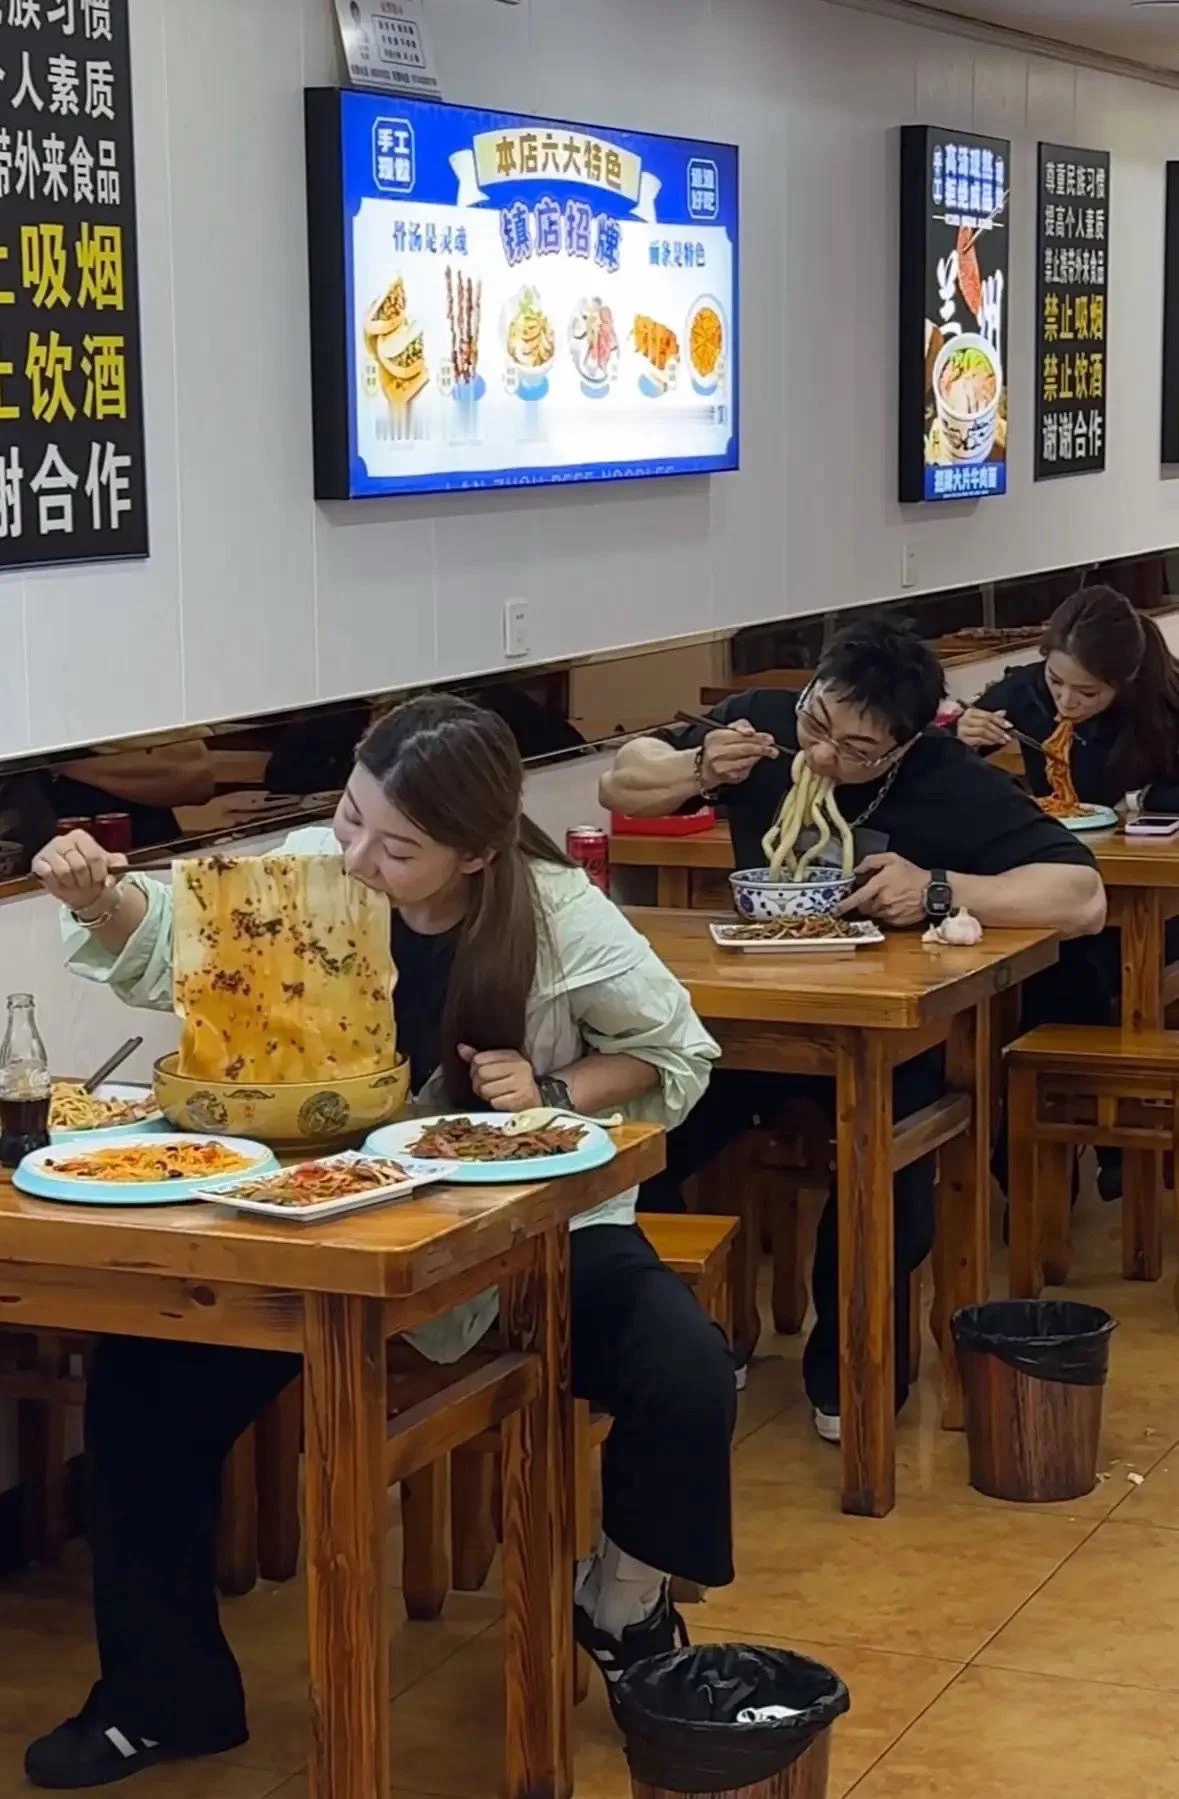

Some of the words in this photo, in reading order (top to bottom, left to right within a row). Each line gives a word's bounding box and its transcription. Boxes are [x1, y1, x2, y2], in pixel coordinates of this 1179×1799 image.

[0, 0, 112, 40] 族习惯
[0, 51, 115, 120] 人素质
[378, 128, 409, 153] 手工
[496, 133, 621, 190] 本店六大特色
[1045, 161, 1105, 199] 尊重民族习惯
[500, 197, 622, 274] 镇店招牌
[1045, 204, 1104, 240] 提高个人素质
[1045, 247, 1104, 284] 禁止携带外来食品
[1044, 292, 1104, 341] 禁止吸烟
[1044, 353, 1103, 402] 禁止饮酒
[1043, 409, 1103, 461] 谢谢合作
